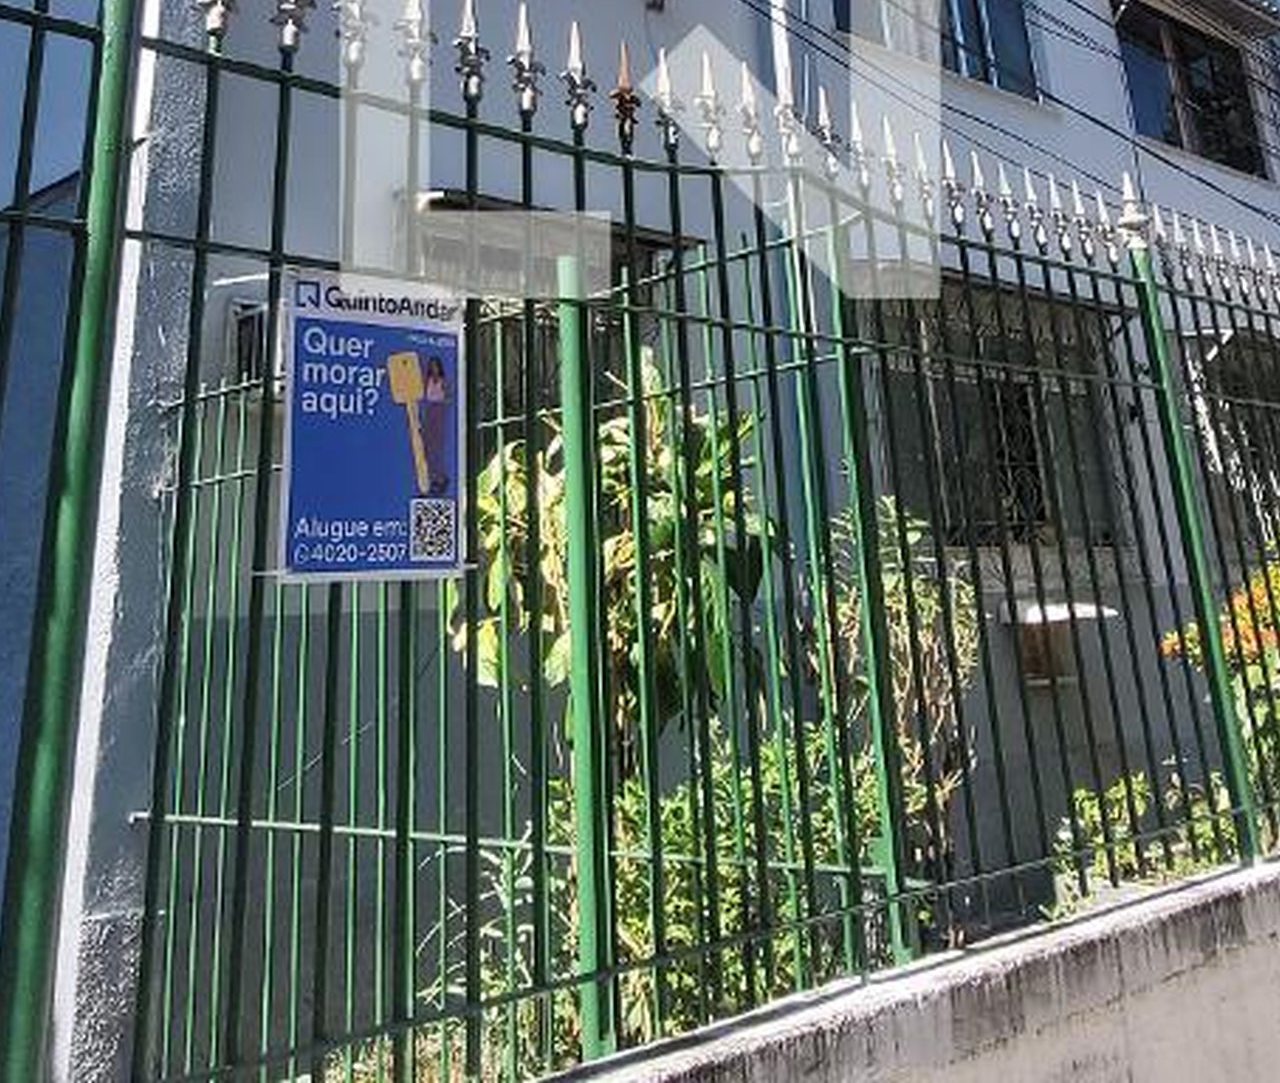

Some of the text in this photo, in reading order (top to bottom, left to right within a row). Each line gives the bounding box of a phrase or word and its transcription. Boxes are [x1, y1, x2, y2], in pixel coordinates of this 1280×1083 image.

[303, 326, 374, 358] Quer
[302, 362, 387, 388] morar
[301, 389, 380, 419] aqui?
[295, 517, 369, 543] Alugue
[311, 543, 408, 562] 4020-2507
